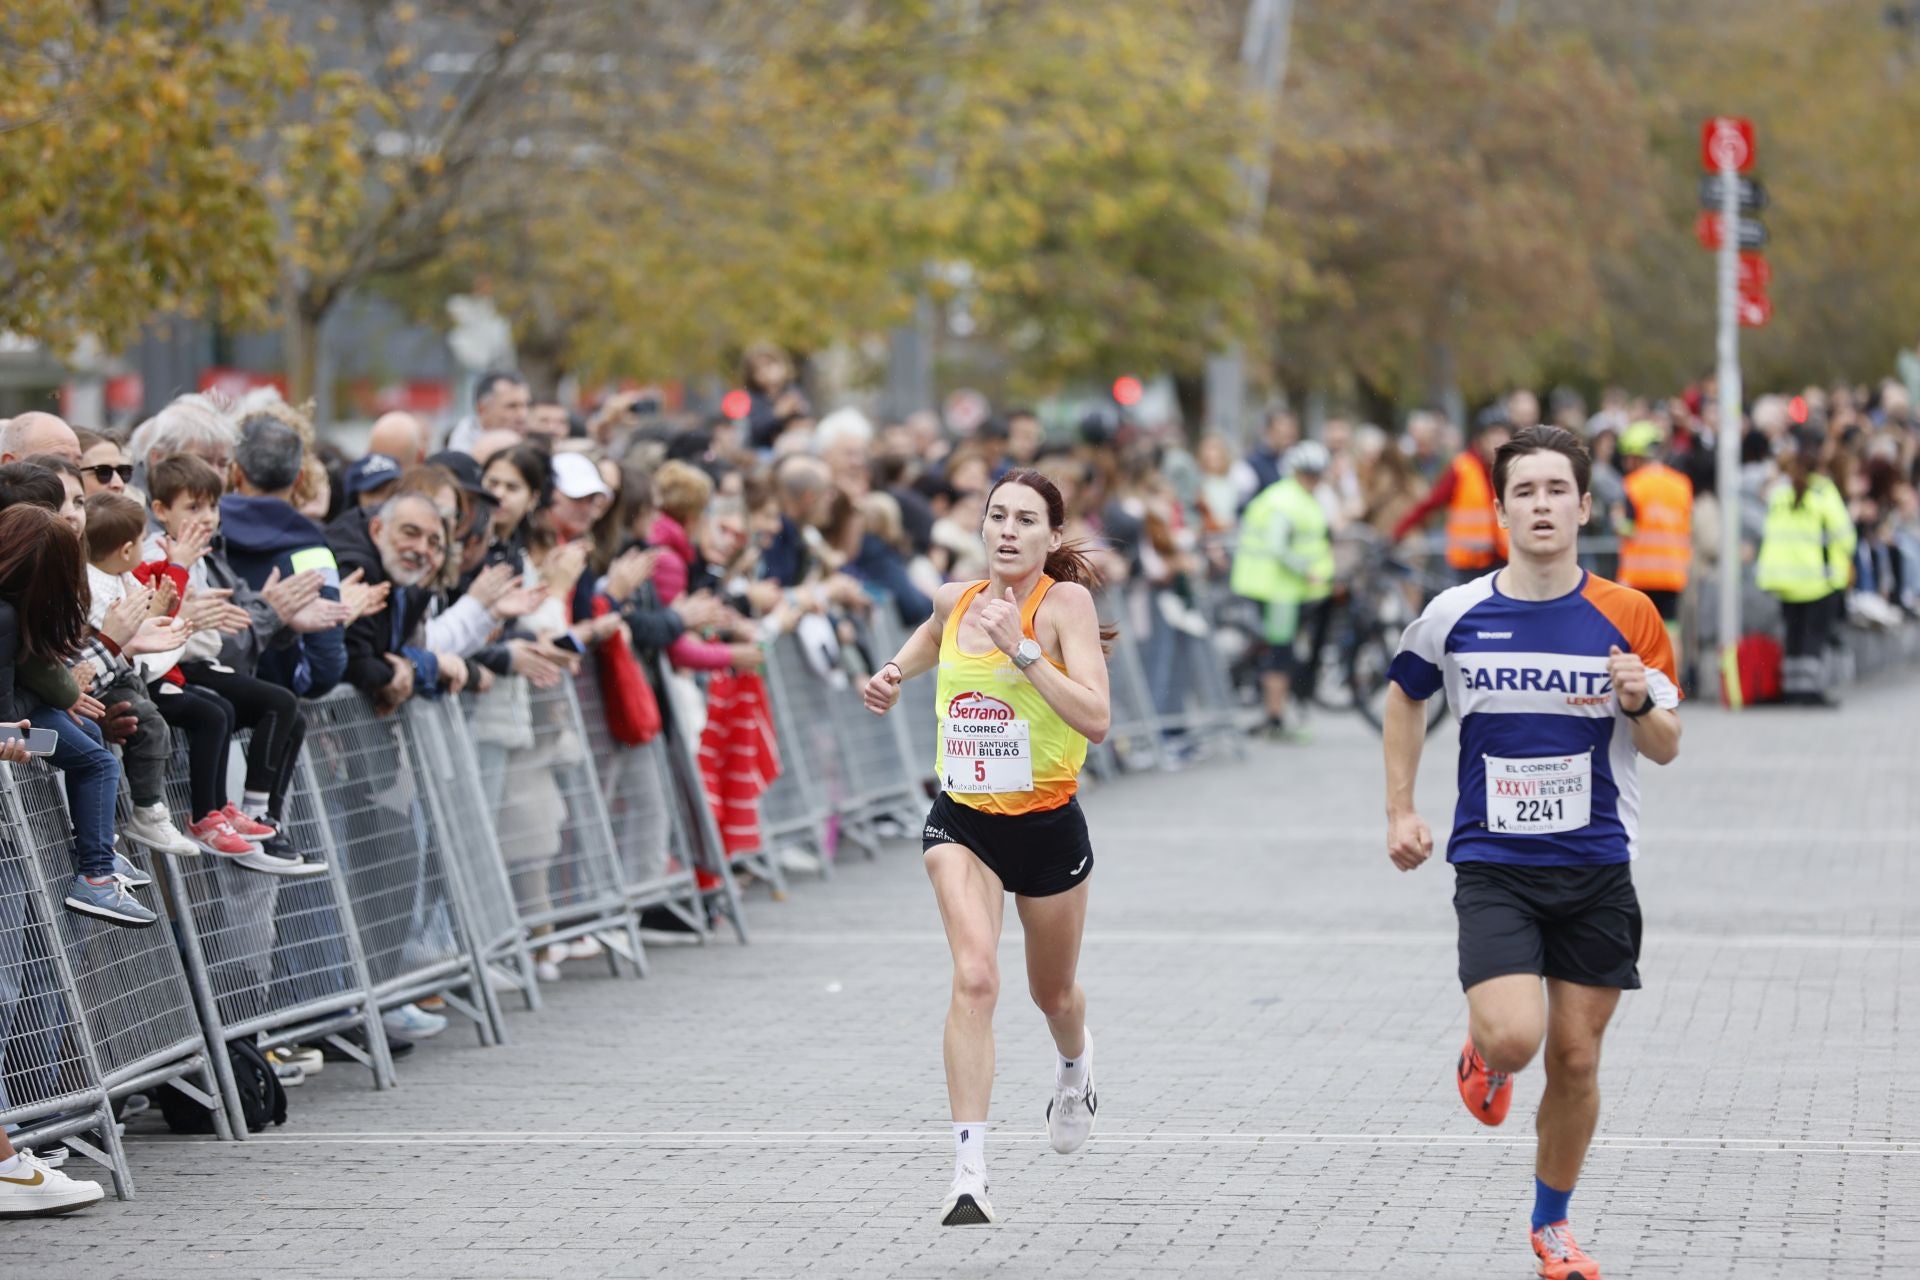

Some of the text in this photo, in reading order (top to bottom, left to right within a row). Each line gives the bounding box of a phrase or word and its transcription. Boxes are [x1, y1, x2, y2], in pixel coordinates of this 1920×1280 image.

[1460, 667, 1613, 695] GARRAITZ
[952, 701, 1008, 720] Serrano
[952, 724, 1005, 734] EL CORREO
[946, 739, 976, 756] XXXVI
[979, 748, 1020, 757] BILBAO
[974, 760, 986, 782] 5
[1505, 764, 1519, 773] EL
[1520, 762, 1569, 773] CORREO
[1496, 779, 1536, 796] XXXVI
[1540, 784, 1583, 795] BILBAO
[1516, 798, 1563, 822] 2241
